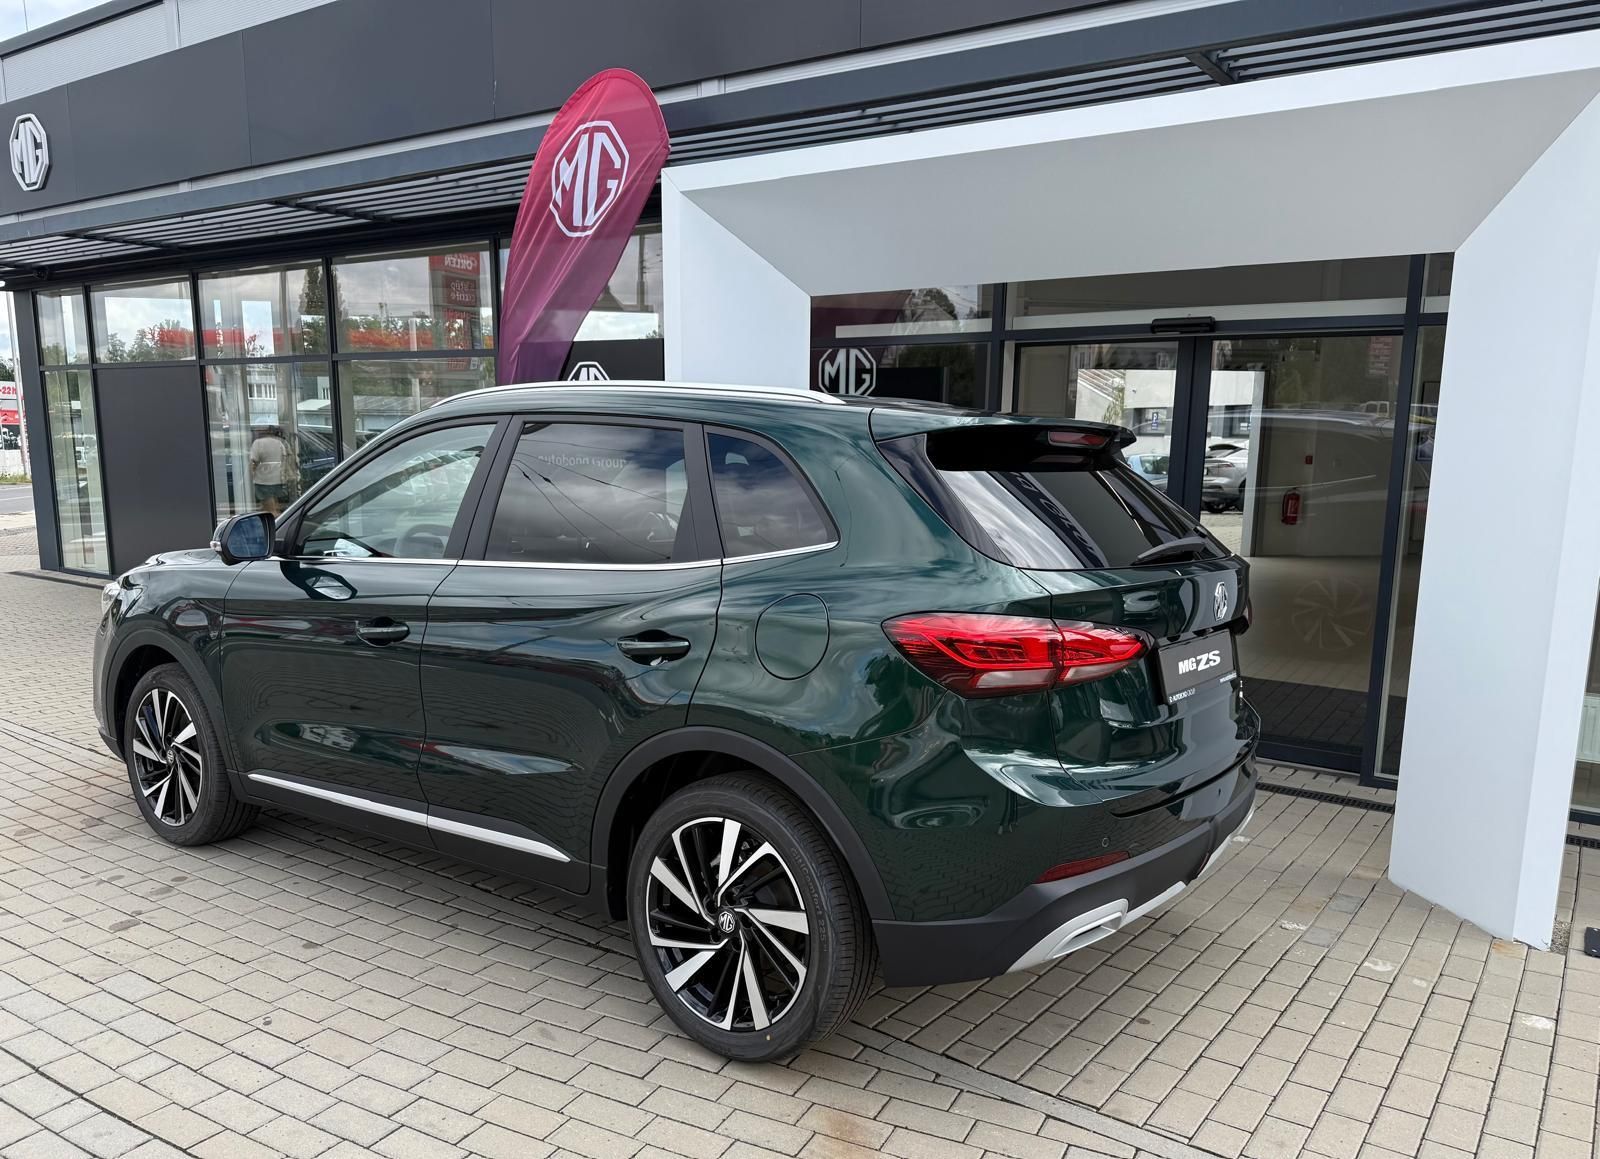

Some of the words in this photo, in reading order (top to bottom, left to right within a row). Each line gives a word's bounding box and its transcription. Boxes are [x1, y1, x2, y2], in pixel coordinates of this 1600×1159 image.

[11, 119, 45, 187] MG
[554, 130, 623, 228] MG
[822, 348, 873, 395] MG
[1178, 657, 1197, 675] MG
[1196, 649, 1221, 672] ZS
[720, 913, 734, 932] MG
